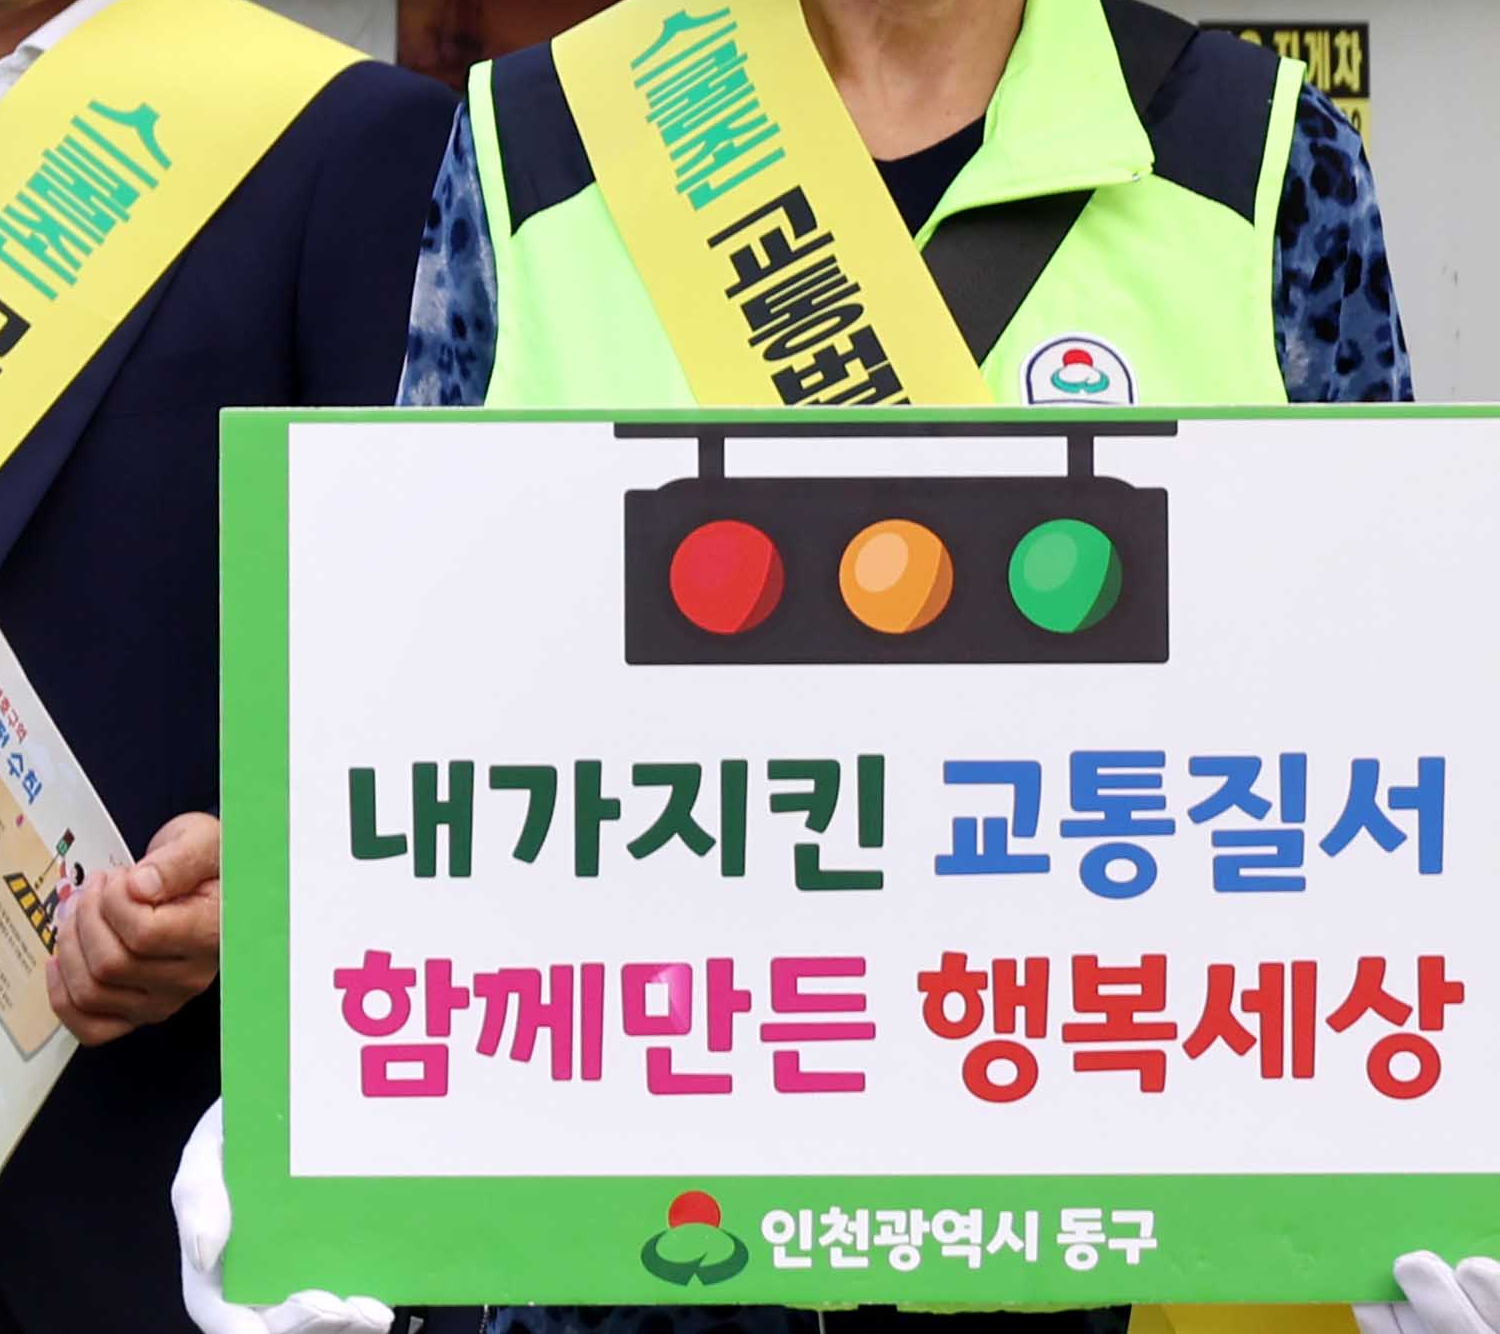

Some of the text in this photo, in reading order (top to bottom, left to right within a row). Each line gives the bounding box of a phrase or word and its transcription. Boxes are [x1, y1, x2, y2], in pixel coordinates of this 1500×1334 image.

[634, 8, 912, 405] 스쿨존 교통법
[6, 751, 43, 806] 수칙
[347, 750, 1447, 901] 내가지킨 교통질서
[333, 949, 1466, 1105] 함께만든 행복세상
[759, 1203, 1160, 1275] 인천광역시 동구
